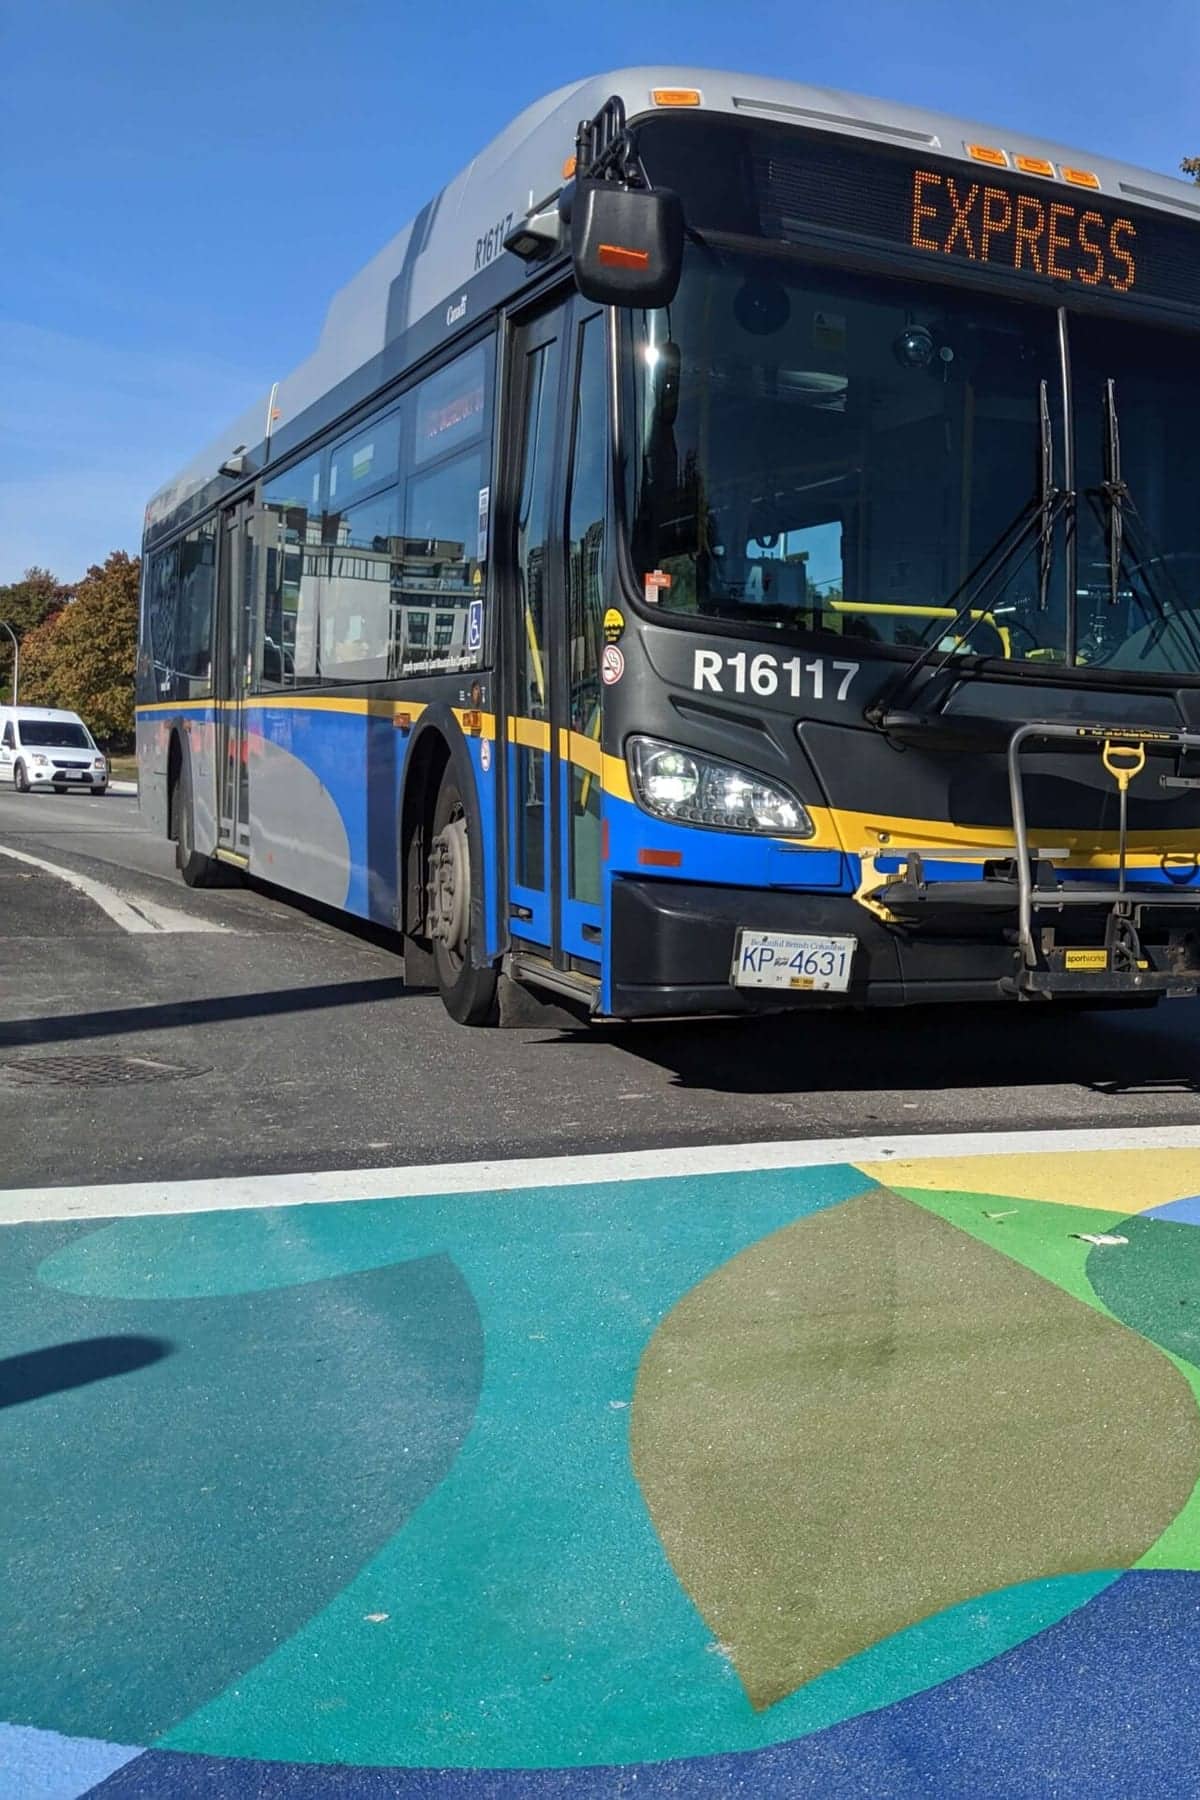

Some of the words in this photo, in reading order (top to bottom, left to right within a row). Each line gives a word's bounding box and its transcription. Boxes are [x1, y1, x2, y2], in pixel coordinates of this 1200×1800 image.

[473, 211, 514, 271] R16117
[911, 169, 1137, 292] EXPRESS
[692, 649, 861, 701] R16117
[742, 946, 775, 972] KP
[788, 950, 846, 977] 4631
